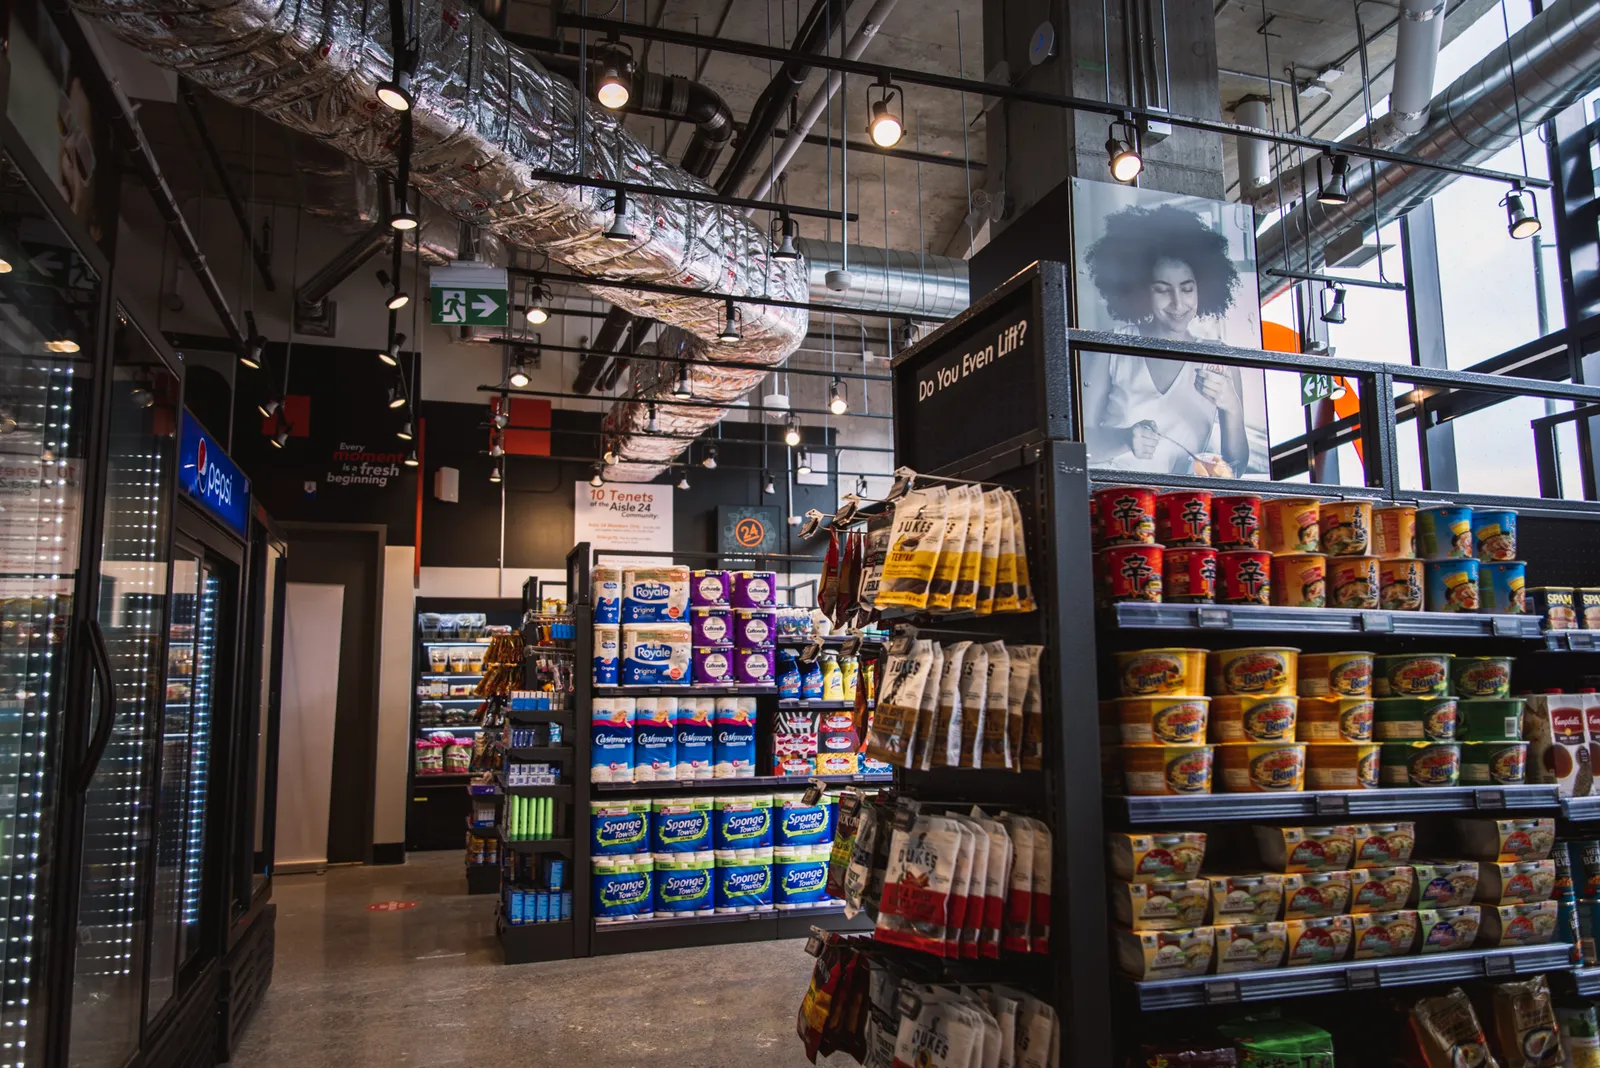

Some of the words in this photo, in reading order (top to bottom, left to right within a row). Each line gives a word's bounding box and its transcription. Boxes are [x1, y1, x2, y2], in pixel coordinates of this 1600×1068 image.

[919, 380, 934, 402] Do
[937, 364, 960, 391] You
[962, 344, 994, 377] Even
[997, 320, 1028, 358] Lift?
[339, 442, 366, 453] Every
[333, 451, 404, 463] moment
[342, 463, 349, 471] is
[360, 462, 400, 476] fresh
[208, 462, 233, 506] pepsi
[327, 472, 388, 487] beginning
[590, 489, 605, 500] 10
[609, 490, 654, 502] Tenets
[609, 502, 636, 511] Aisle
[637, 503, 651, 512] 24
[621, 512, 658, 520] Community:
[1113, 495, 1143, 535] 辛
[1181, 499, 1207, 535] 辛
[1230, 503, 1257, 540] 辛
[741, 524, 758, 539] 24
[1121, 554, 1153, 593] 辛
[1237, 558, 1265, 596] 辛
[636, 587, 669, 599] Royale
[1547, 594, 1573, 605] SPAM
[1583, 594, 1600, 605] SPA
[637, 647, 671, 660] Royale
[595, 733, 633, 745] Cashmere
[638, 733, 674, 745] Cashmere
[678, 732, 713, 743] Cashmere
[719, 731, 754, 743] Cashmere
[666, 818, 702, 832] Sponge
[729, 815, 764, 829] Sponge
[788, 812, 822, 826] Sponge
[799, 821, 820, 830] Towels
[603, 820, 641, 834] Sponge
[615, 829, 638, 838] Towels
[677, 828, 699, 836] Towels
[740, 825, 761, 833] Towels
[898, 849, 938, 869] DUKES
[729, 872, 765, 886] Sponge
[788, 869, 822, 883] Sponge
[799, 878, 820, 887] Towels
[607, 880, 645, 895] Sponge
[667, 877, 704, 891] Sponge
[678, 886, 700, 895] Towels
[741, 882, 762, 891] Towels
[618, 890, 641, 899] Towels
